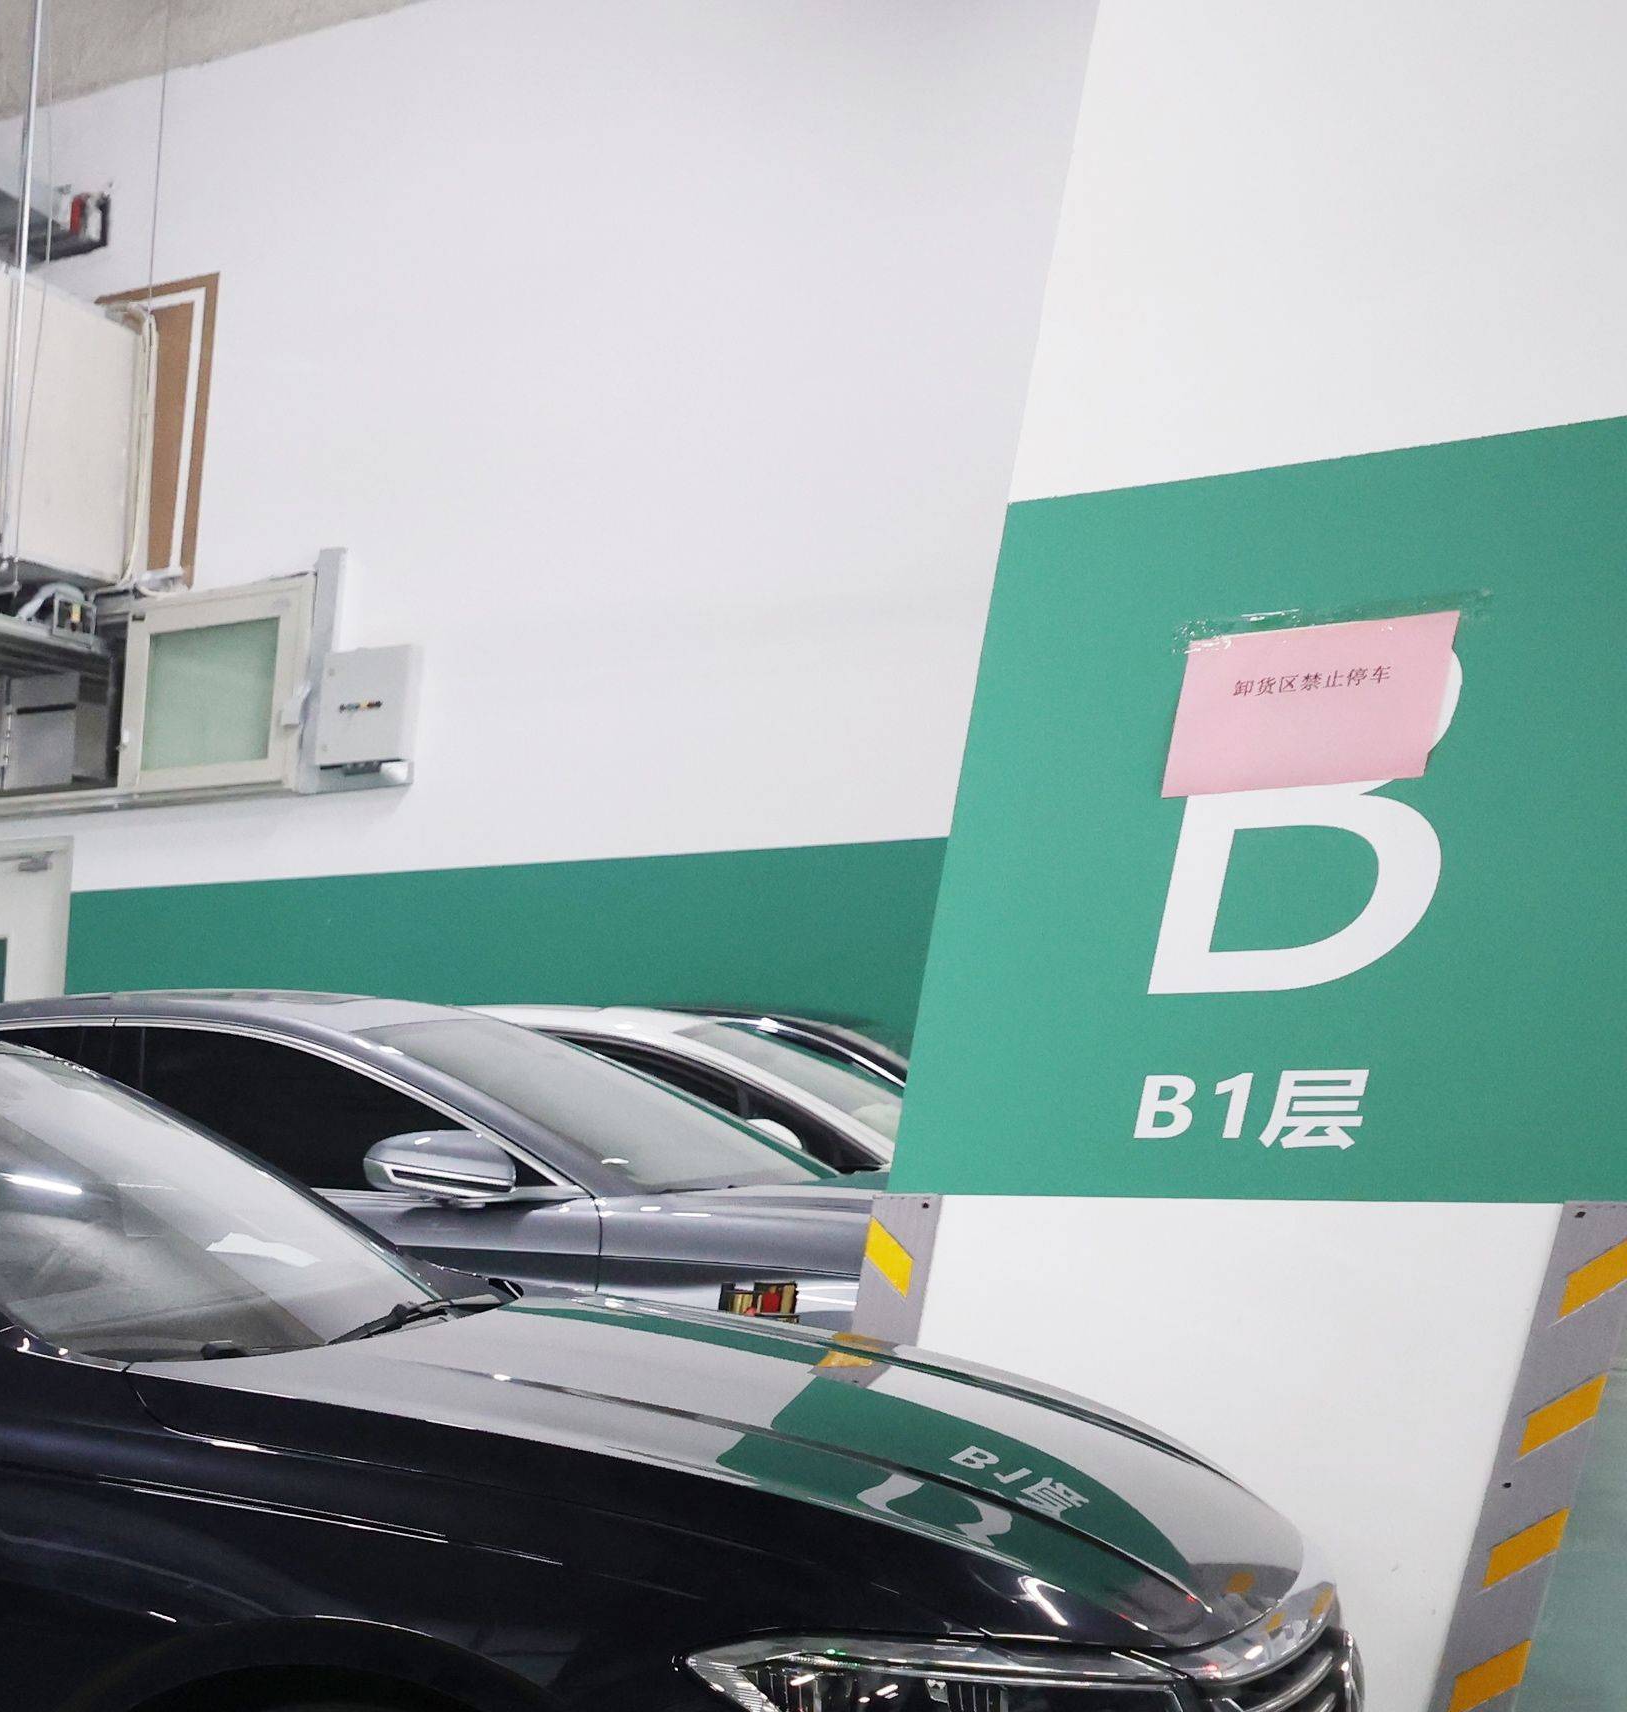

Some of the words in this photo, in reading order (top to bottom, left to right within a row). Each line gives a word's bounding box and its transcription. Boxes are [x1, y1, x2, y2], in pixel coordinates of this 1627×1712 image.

[1232, 665, 1392, 697] 卸货区禁止停车
[1132, 1068, 1370, 1151] B1层
